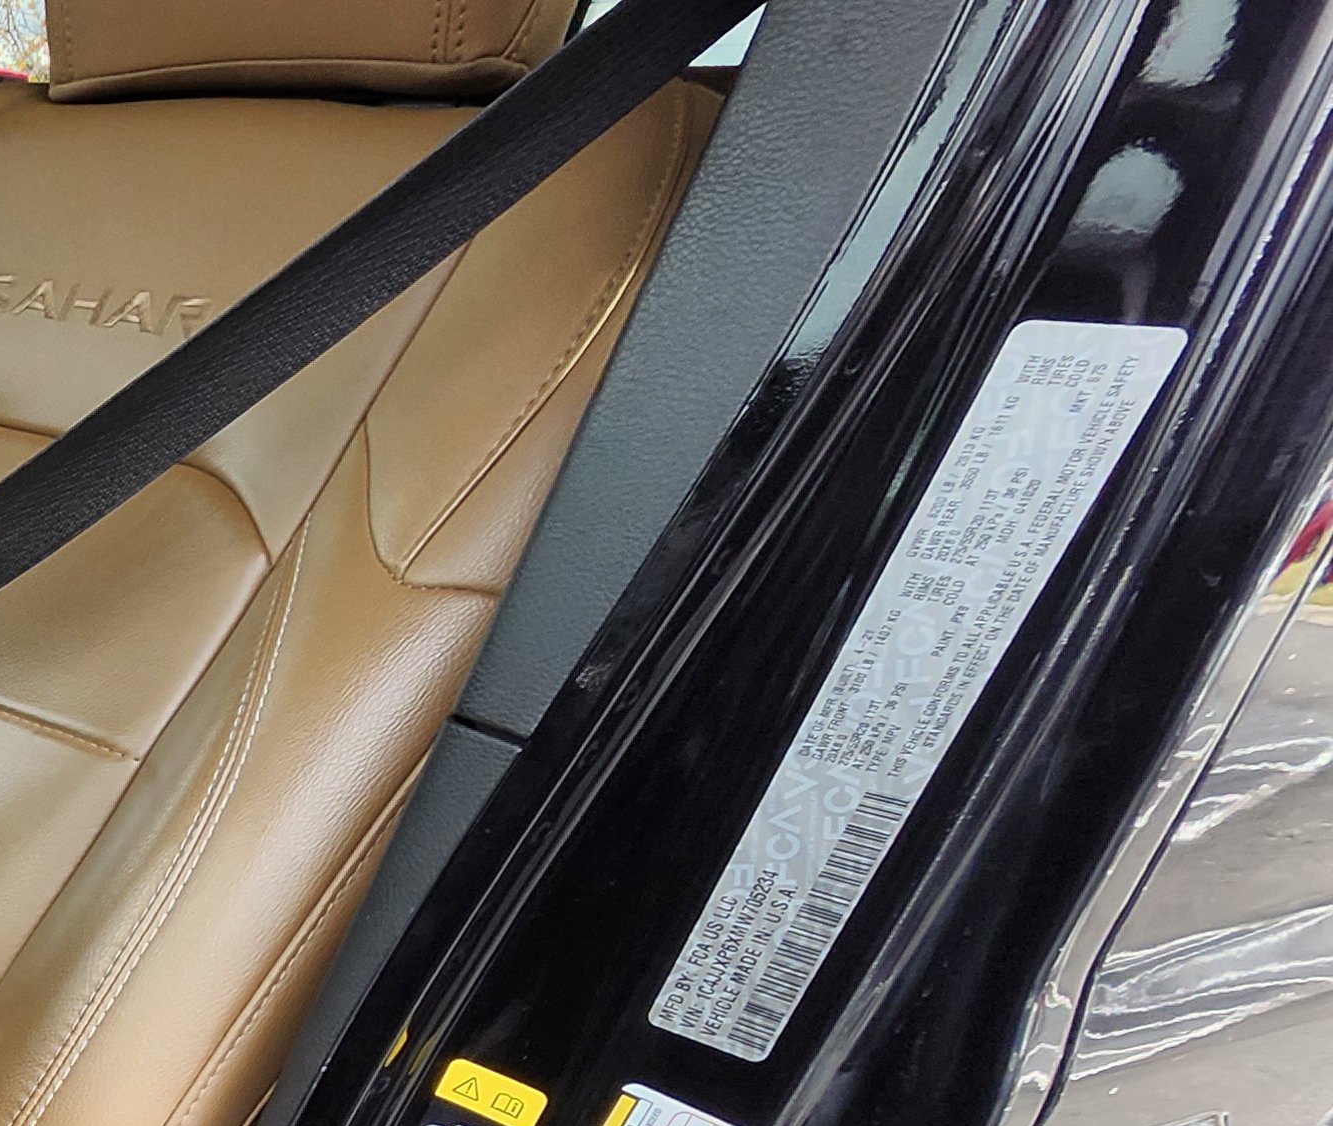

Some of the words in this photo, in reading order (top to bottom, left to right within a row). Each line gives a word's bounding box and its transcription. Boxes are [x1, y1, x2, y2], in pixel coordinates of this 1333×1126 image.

[1032, 358, 1056, 384] RIMS
[1048, 355, 1075, 385] TIRES
[1065, 359, 1090, 386] COLD
[888, 757, 906, 777] THIS
[901, 718, 929, 755] VEHICLE
[922, 665, 959, 716] CONFORMS
[961, 631, 980, 648] ALL
[972, 570, 1015, 628] APPLICABLE
[1027, 488, 1063, 533] FEDERAL
[1056, 448, 1086, 483] MOTOR
[1079, 401, 1113, 444] VEHICLE
[1105, 355, 1140, 396] SAFETY
[923, 693, 962, 747] STANDARDS
[963, 644, 991, 677] EFFECT
[985, 626, 1001, 640] ON
[994, 606, 1013, 623] THE
[1007, 576, 1031, 601] DATE
[1034, 481, 1087, 556] MANUFACTURE
[1079, 439, 1111, 476] SHOWN
[1104, 400, 1134, 433] ABOVE
[913, 576, 935, 600] RIMS
[927, 575, 951, 602] TIRES
[942, 580, 965, 605] COLD
[812, 732, 834, 760] GAWR
[900, 572, 921, 597] WITH
[712, 895, 737, 918] LLC
[701, 920, 724, 939] US
[680, 1003, 705, 1029] VIN:
[696, 869, 779, 1000] 1C4JJXP6XMW705234
[687, 941, 713, 966] FCA
[701, 986, 740, 1037] VEHICLE
[730, 947, 762, 984] MADE
[751, 925, 774, 945] IN:
[763, 883, 797, 923] U.S.A.
[674, 969, 697, 991] BY:
[658, 992, 685, 1021] MFD
